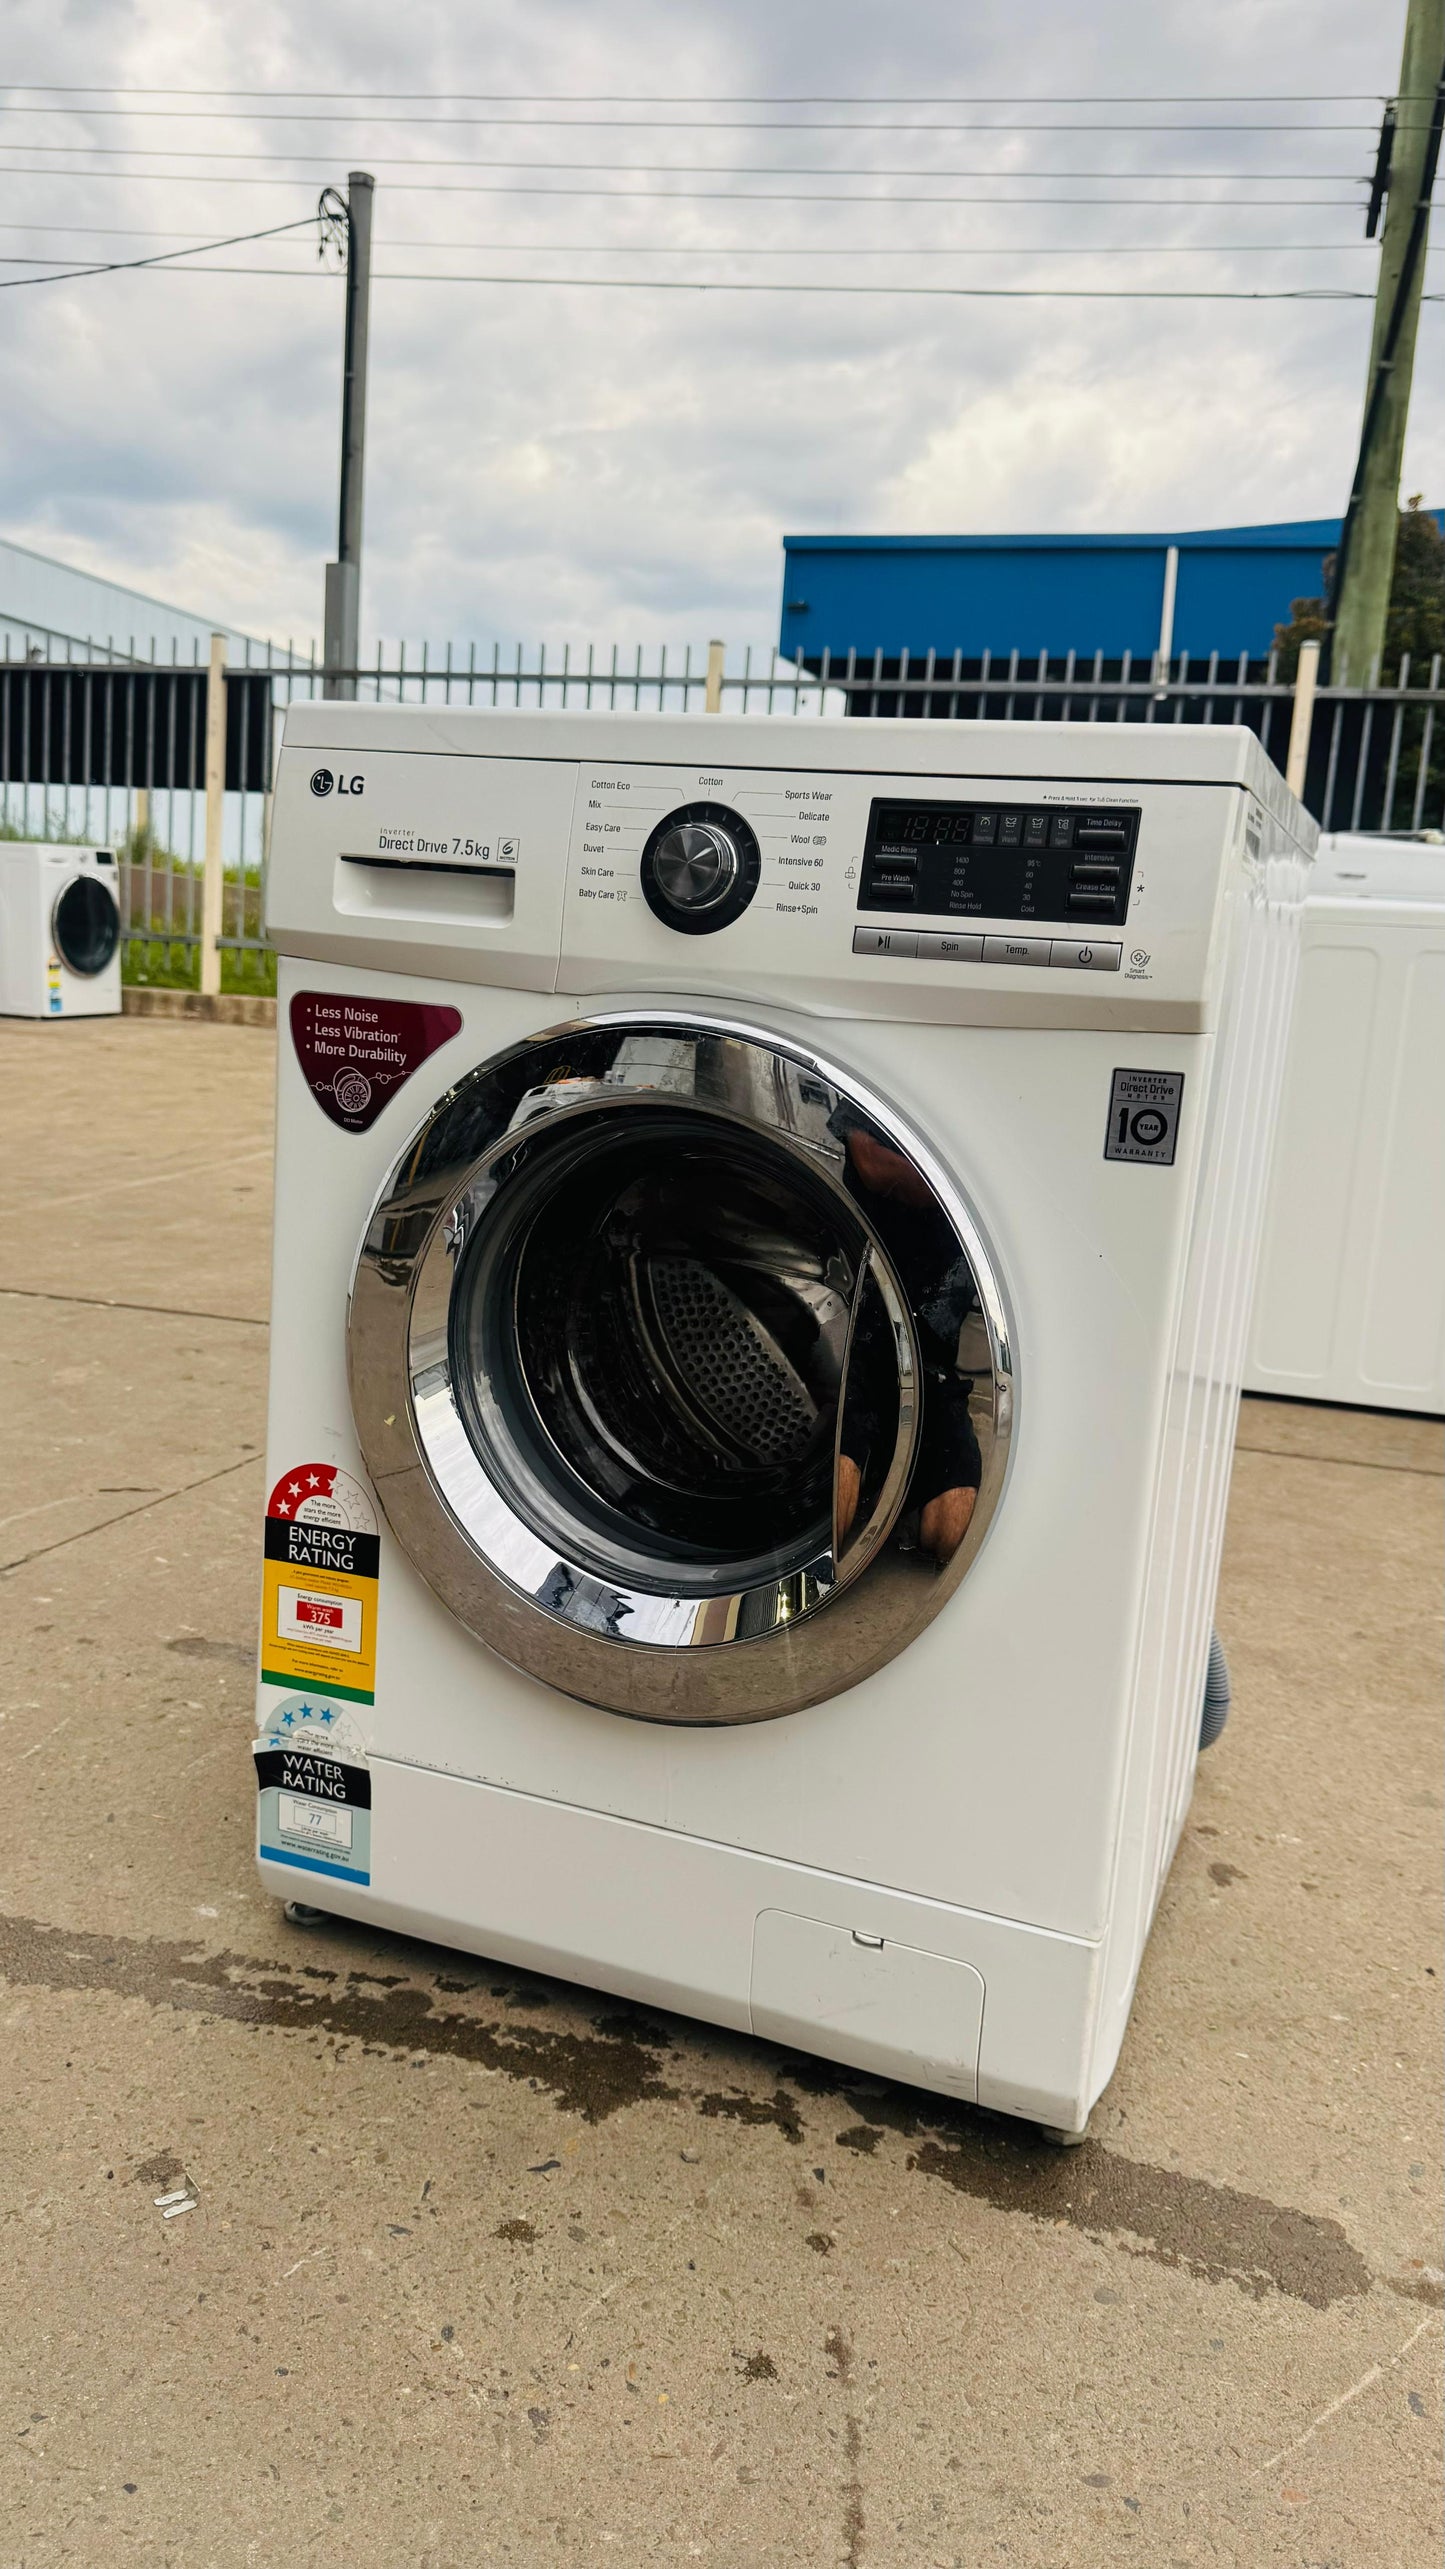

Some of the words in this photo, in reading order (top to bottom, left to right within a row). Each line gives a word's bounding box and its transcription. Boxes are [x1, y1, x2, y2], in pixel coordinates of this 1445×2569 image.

[337, 774, 365, 795] LG
[591, 780, 616, 790] Cotton
[616, 781, 631, 791] Eco
[698, 776, 724, 786] Cotton
[784, 790, 810, 802] Sports
[811, 792, 833, 801] Wear
[588, 800, 602, 809] Mix
[798, 812, 830, 822] Delicate
[585, 823, 603, 834] Easy
[604, 824, 621, 833] Care
[1087, 818, 1103, 826] Time
[1103, 819, 1122, 828] Delay
[380, 828, 415, 836] Inverter
[790, 835, 810, 844] Wool
[379, 836, 414, 852] Direct
[417, 839, 448, 854] Drive
[452, 838, 490, 859] 7.5kg
[583, 844, 605, 853] Duvet
[881, 845, 899, 853] Medic
[901, 846, 917, 854] Rinse
[778, 856, 813, 867] Intensive
[813, 858, 824, 867] 60
[1084, 854, 1115, 862] Intensive
[581, 867, 596, 876] Skin
[597, 868, 614, 877] Care
[893, 874, 910, 882] Wash
[788, 881, 810, 891] Quick
[810, 882, 821, 891] 30
[1075, 883, 1099, 891] Crease
[1099, 883, 1115, 892] Care
[578, 889, 596, 900] Baby
[597, 890, 615, 899] Care
[951, 890, 960, 898] No
[960, 891, 974, 899] Spin
[775, 903, 818, 914] Rinse+Spin
[950, 901, 967, 910] Rinse
[967, 902, 982, 910] Hold
[1021, 905, 1035, 913] Cold
[941, 941, 959, 952] Spin
[1005, 944, 1029, 956] Temp.
[315, 1004, 341, 1019] Less
[344, 1007, 379, 1023] Noise
[314, 1022, 341, 1038] Less
[314, 1040, 346, 1056] More
[348, 1044, 407, 1067] Durability
[1129, 1076, 1167, 1084] INVERTER
[1120, 1082, 1148, 1093] Direct
[1149, 1084, 1174, 1095] Drive
[1127, 1093, 1165, 1101] MOTOR
[1118, 1107, 1168, 1146] 10
[1139, 1123, 1159, 1132] YEAR
[1114, 1148, 1167, 1158] WARRANTY
[311, 1499, 321, 1507] The
[303, 1515, 320, 1523] energy
[321, 1517, 341, 1525] efficient
[289, 1526, 357, 1552] ENERGY
[288, 1544, 354, 1570] RATING
[297, 1593, 313, 1602] Energy
[313, 1596, 343, 1606] consumption
[310, 1610, 331, 1625] 375
[303, 1623, 315, 1631] kWh
[323, 1627, 335, 1635] year
[283, 1753, 345, 1782] WATER
[283, 1770, 346, 1799] RATING
[308, 1802, 338, 1814] Consumption
[309, 1813, 322, 1826] 77
[281, 1840, 350, 1862] www.waterrating.gov.au
